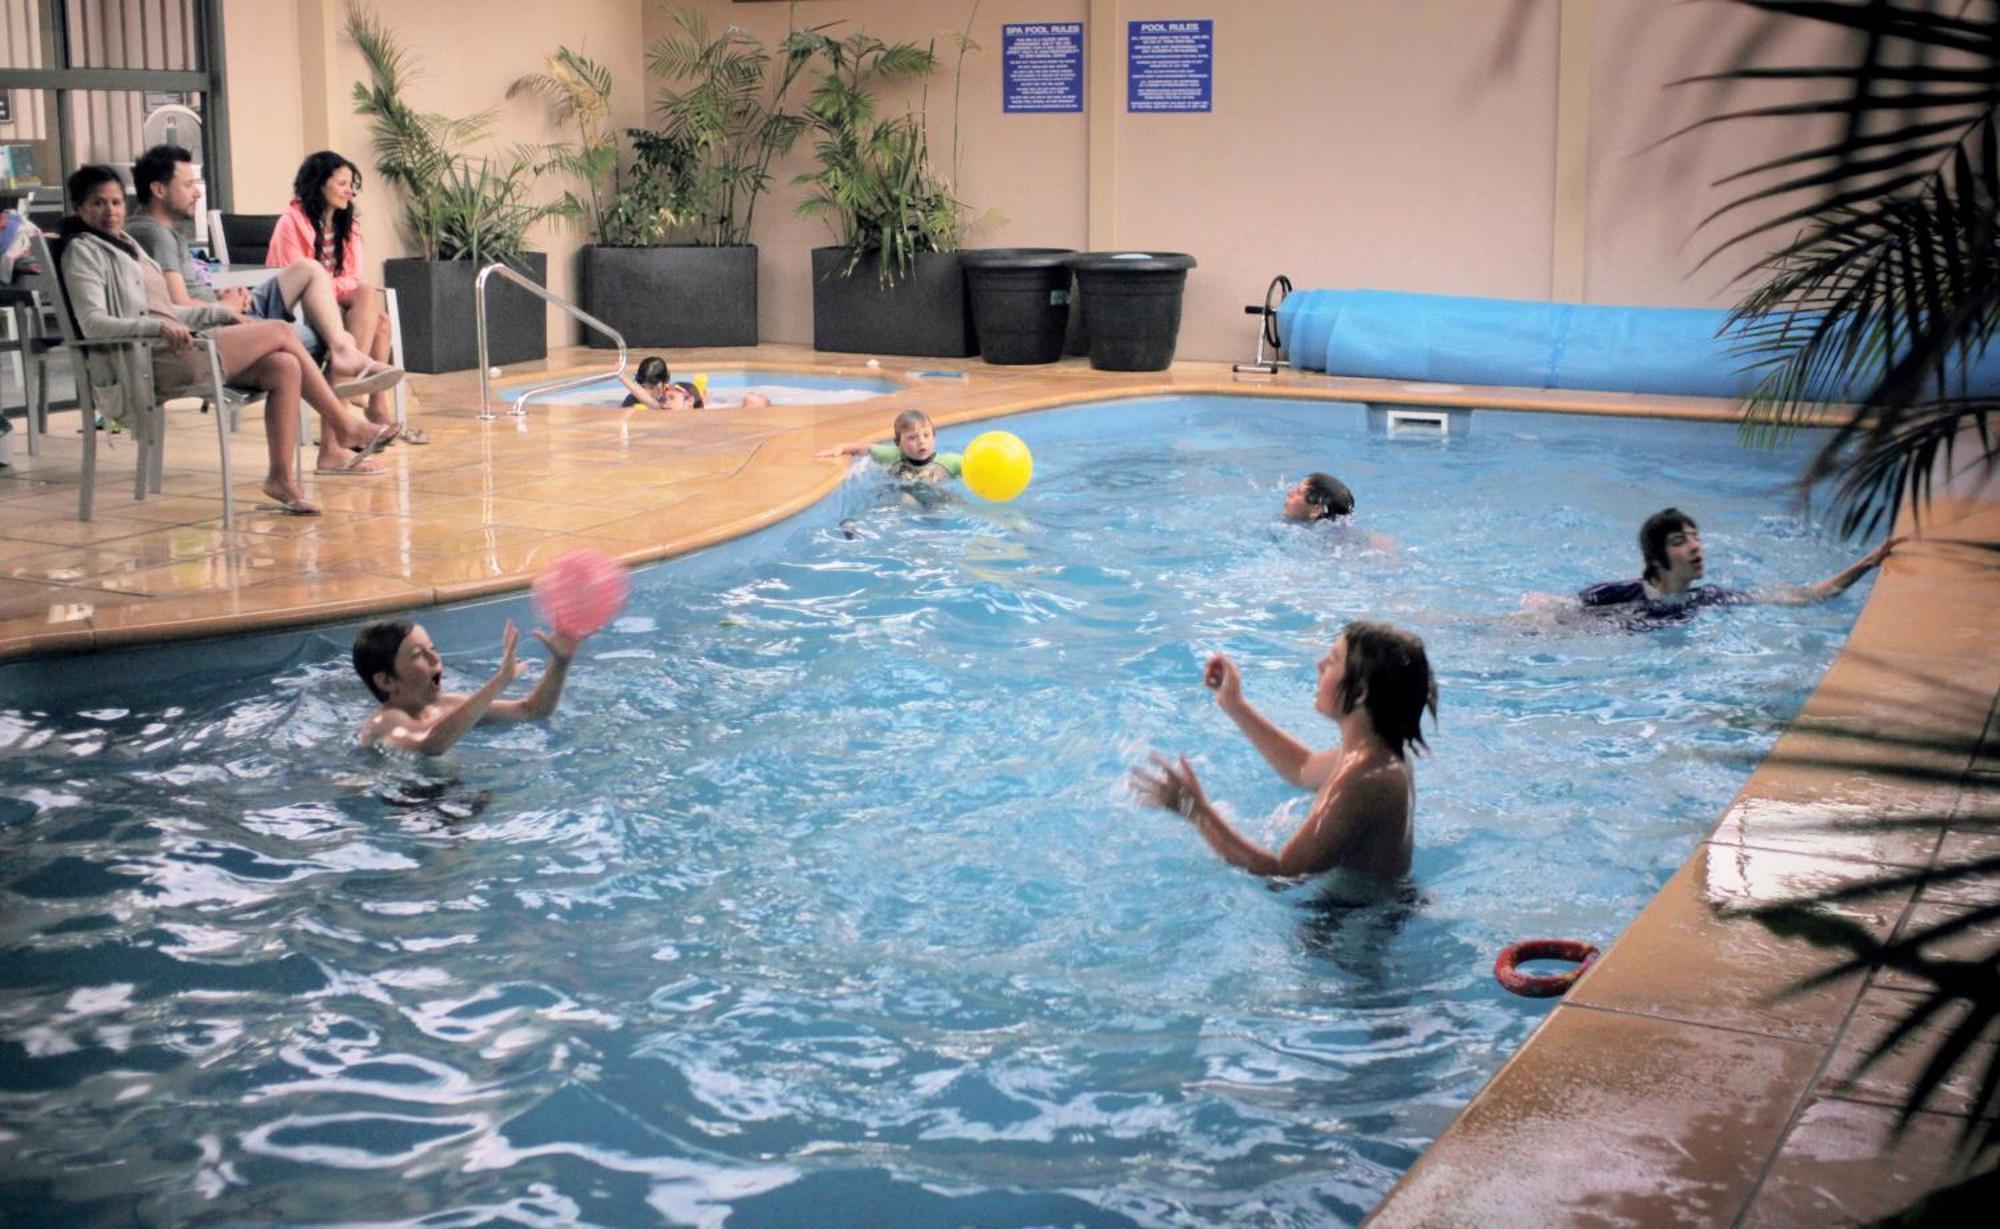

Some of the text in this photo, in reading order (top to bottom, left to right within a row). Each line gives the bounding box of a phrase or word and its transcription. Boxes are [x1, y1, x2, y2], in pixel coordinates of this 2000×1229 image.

[1006, 26, 1023, 34] SPA
[1051, 25, 1079, 33] RULES
[1169, 23, 1199, 31] RULES
